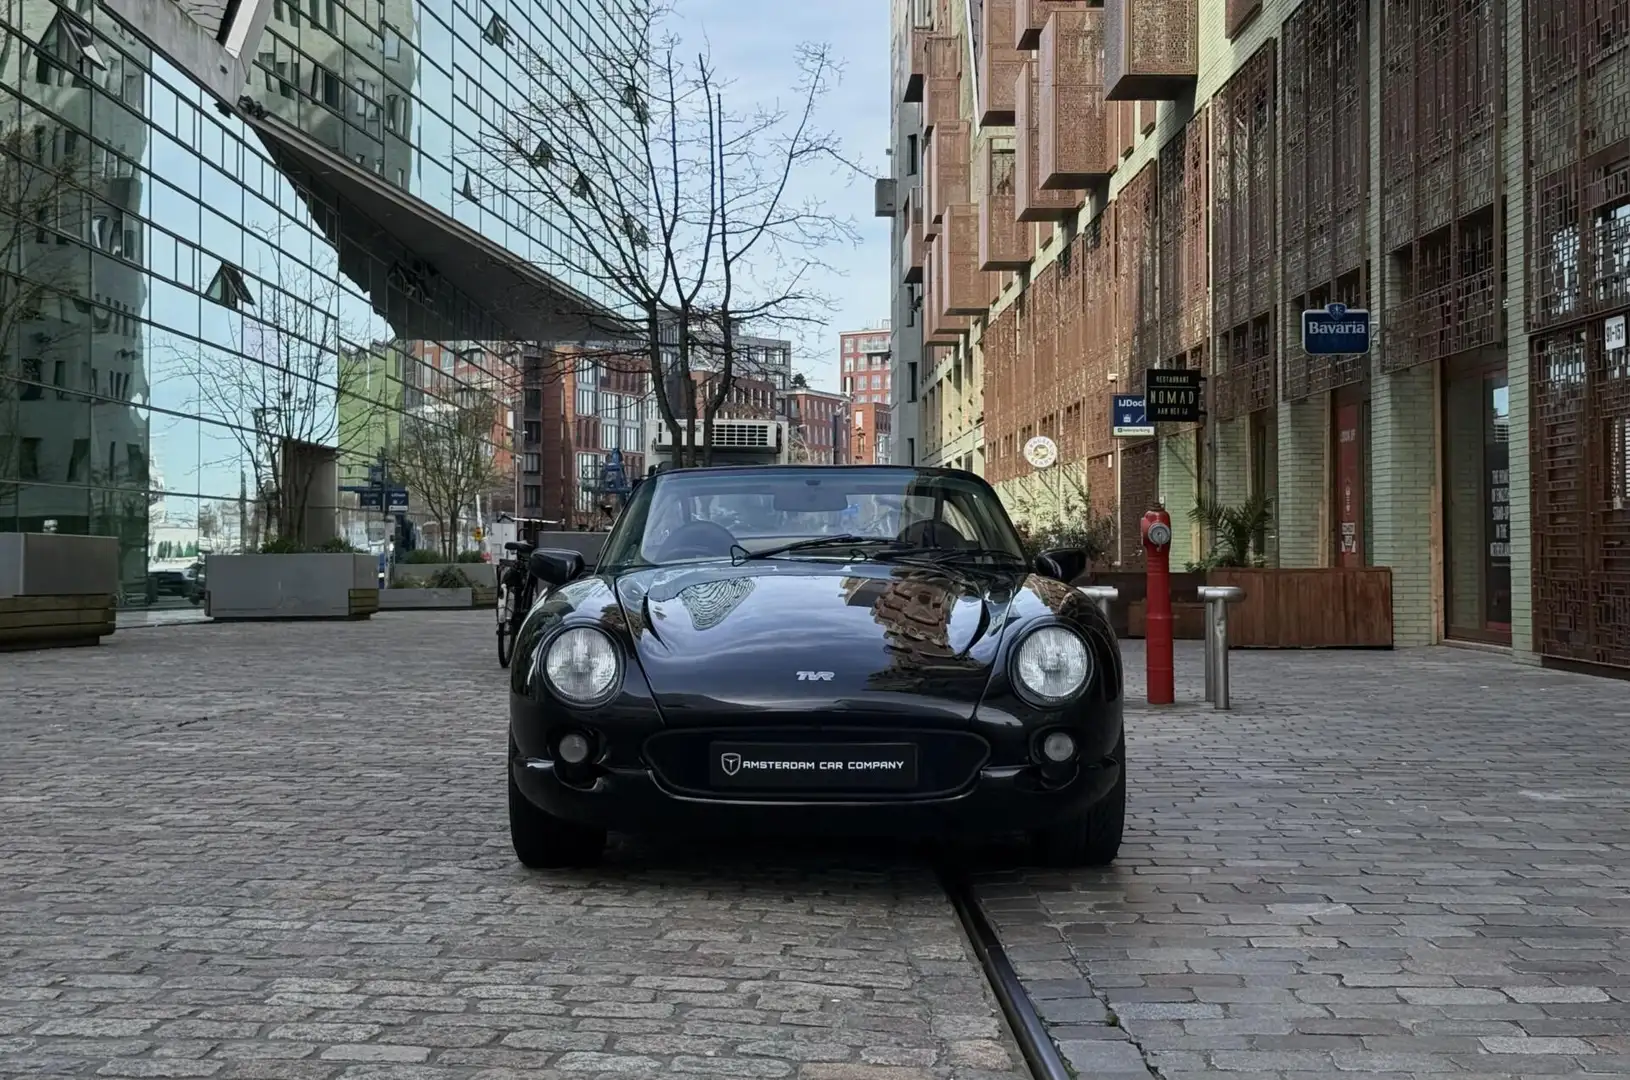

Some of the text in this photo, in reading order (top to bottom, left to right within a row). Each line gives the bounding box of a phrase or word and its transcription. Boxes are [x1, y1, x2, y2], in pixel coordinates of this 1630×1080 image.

[1308, 321, 1366, 334] Bavaria
[1156, 375, 1189, 384] RESTAURANT
[1150, 390, 1194, 405] NOMAD
[796, 670, 835, 681] TVR
[742, 760, 904, 770] AMSTERDAM CAR COMPANY
